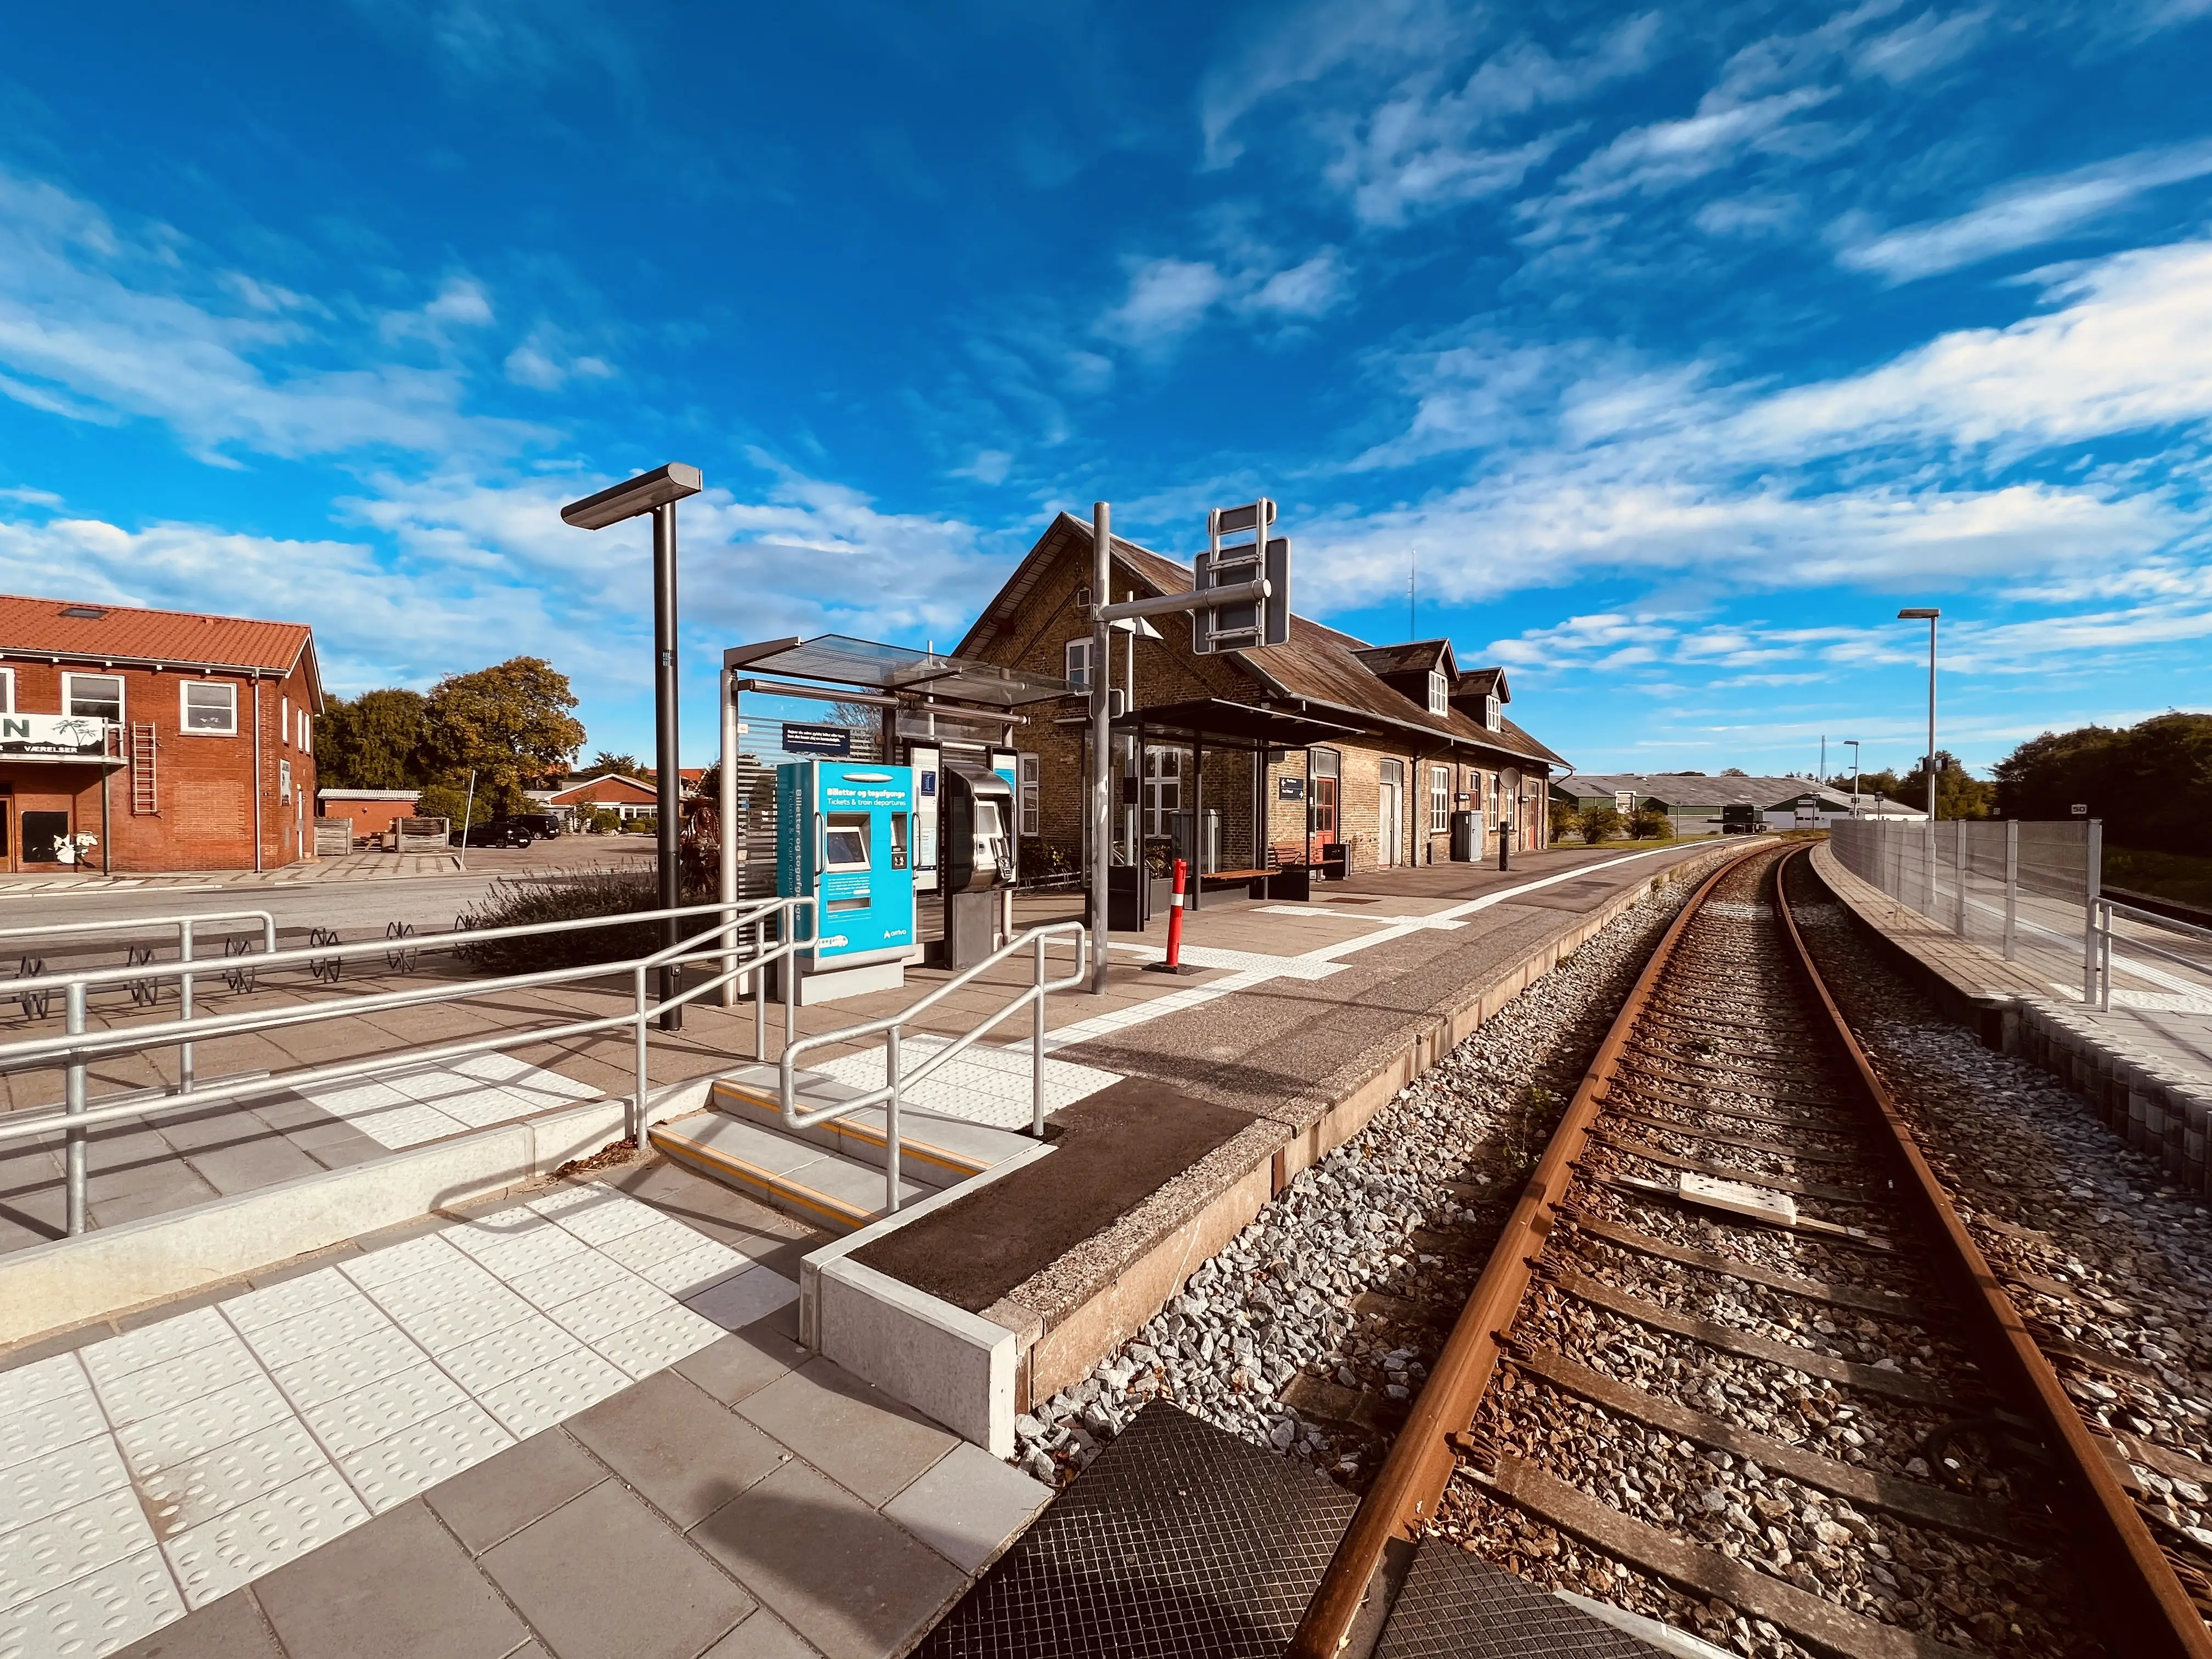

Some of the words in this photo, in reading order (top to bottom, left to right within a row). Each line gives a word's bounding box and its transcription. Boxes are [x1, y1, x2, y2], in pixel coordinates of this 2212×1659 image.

[827, 788, 856, 796] Billetter
[867, 789, 906, 799] togafgange
[794, 838, 801, 851] og
